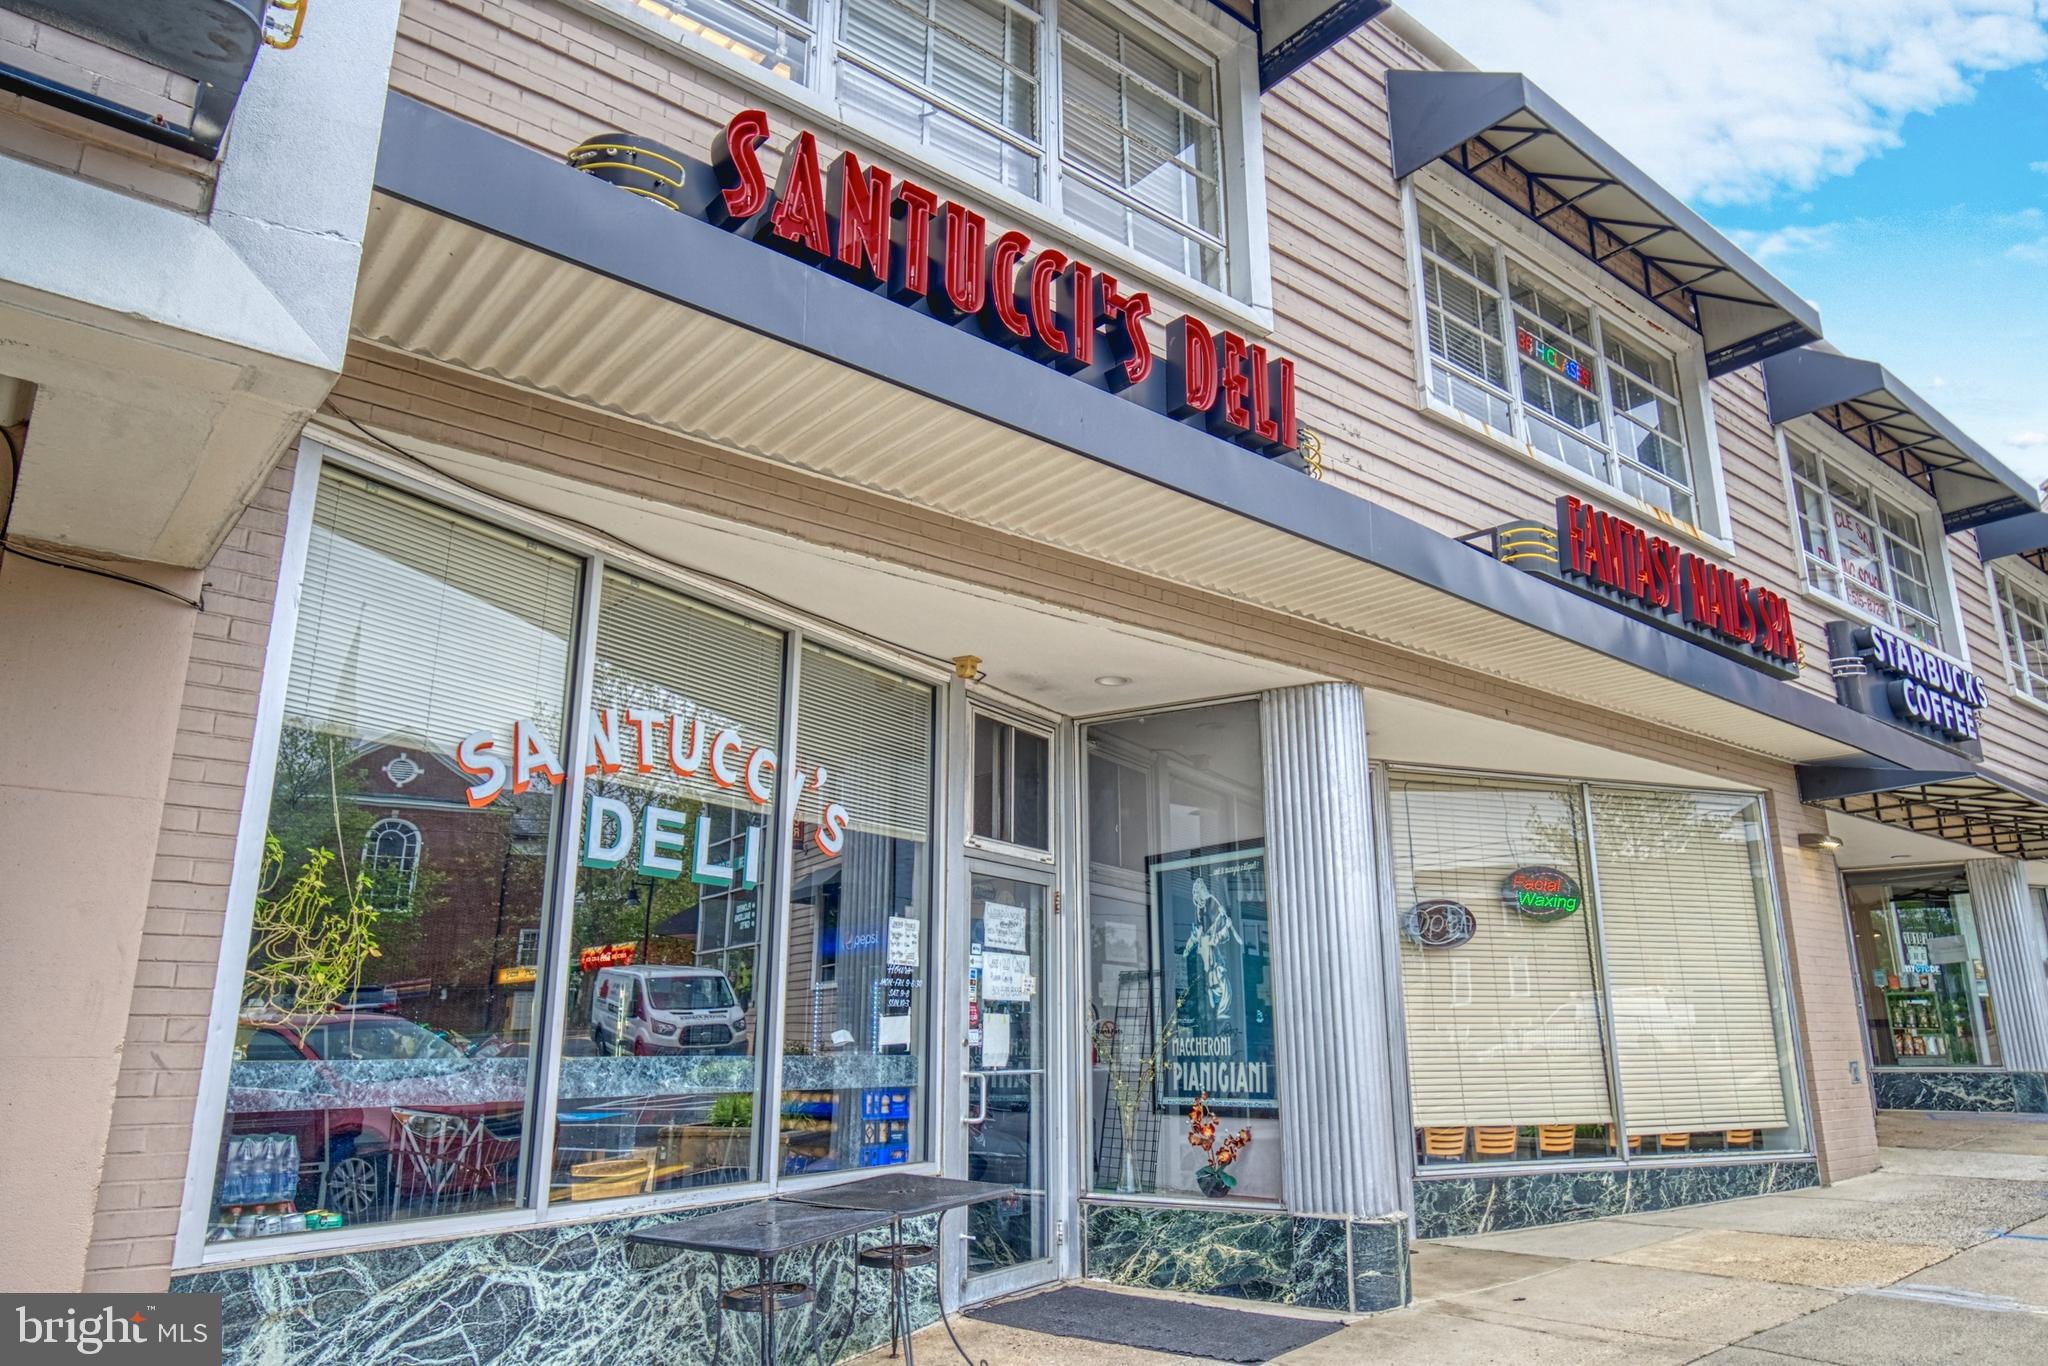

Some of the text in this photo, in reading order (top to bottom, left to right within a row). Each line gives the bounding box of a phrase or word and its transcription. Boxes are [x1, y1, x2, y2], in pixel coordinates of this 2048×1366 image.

[719, 110, 1298, 451] SANTUCCI'S DELI
[1566, 494, 1798, 666] FANTASY NAILS SPA
[1870, 624, 1989, 710] STARBUCKS
[1903, 678, 1979, 740] COFFEE
[582, 796, 761, 890] DELI
[1512, 874, 1561, 892] Facial
[1518, 891, 1577, 912] Waxing
[853, 930, 879, 949] pepsi
[1410, 908, 1474, 940] Open
[1171, 1036, 1232, 1057] MACCHERONI
[1173, 1061, 1268, 1093] PIANIGIANI
